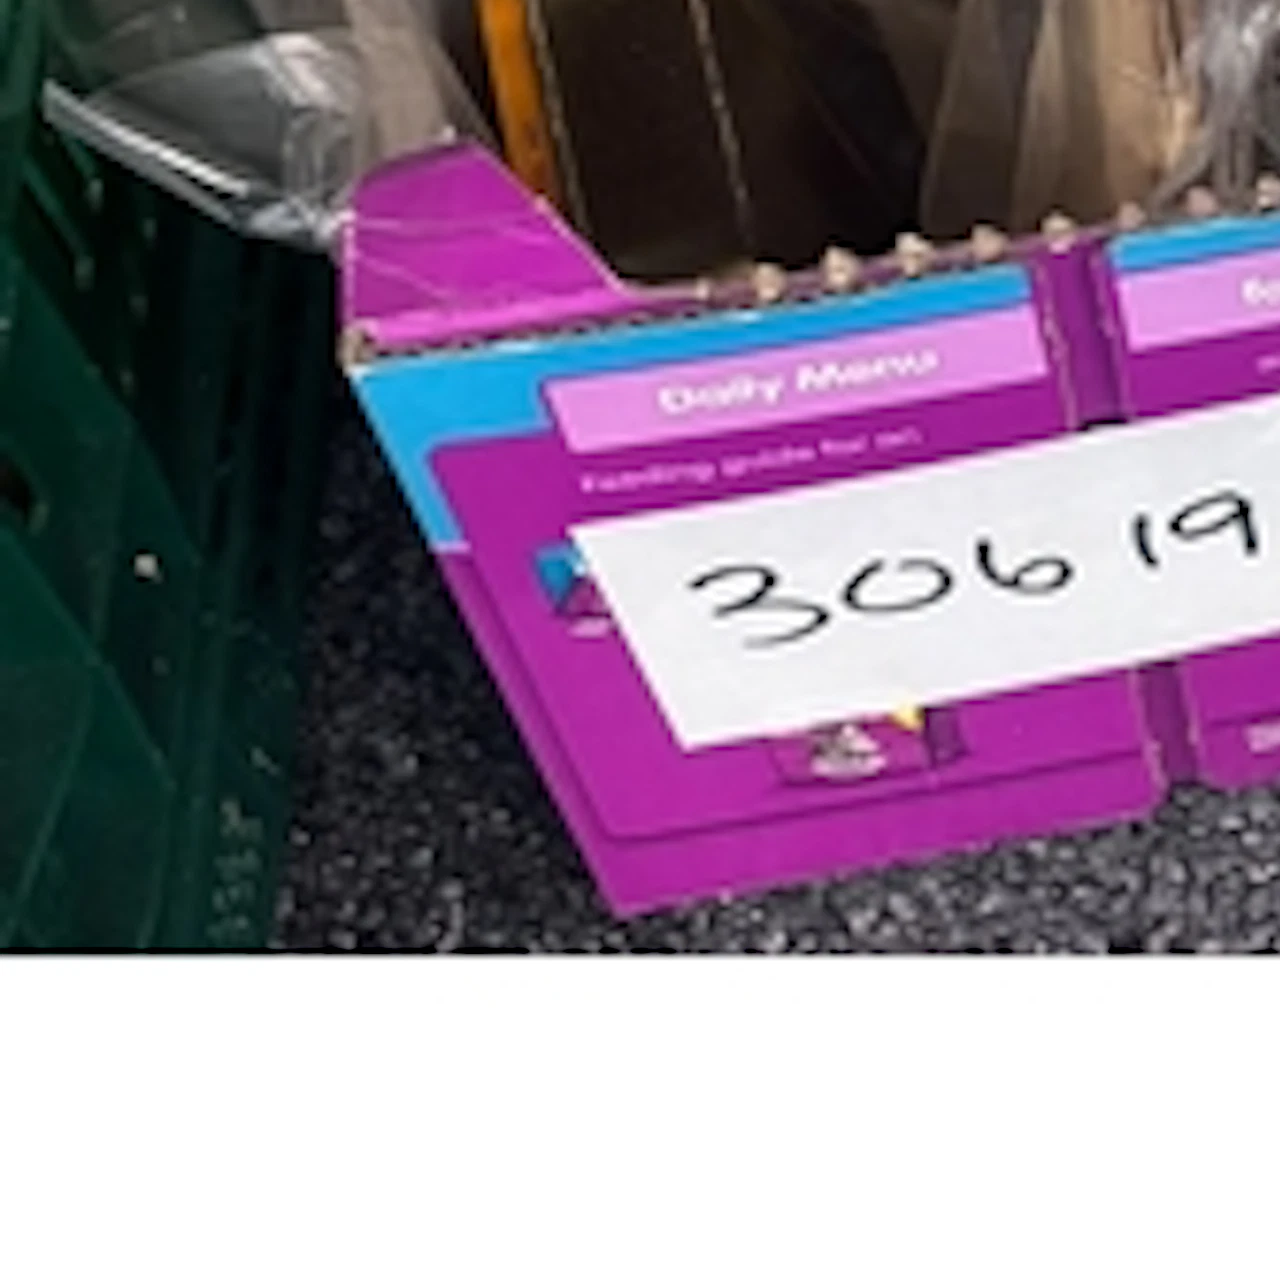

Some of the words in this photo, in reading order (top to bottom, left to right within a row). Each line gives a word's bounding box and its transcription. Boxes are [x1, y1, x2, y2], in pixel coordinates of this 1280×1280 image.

[655, 372, 785, 415] Daily
[796, 348, 939, 394] Menu
[684, 487, 1260, 651] 30619
